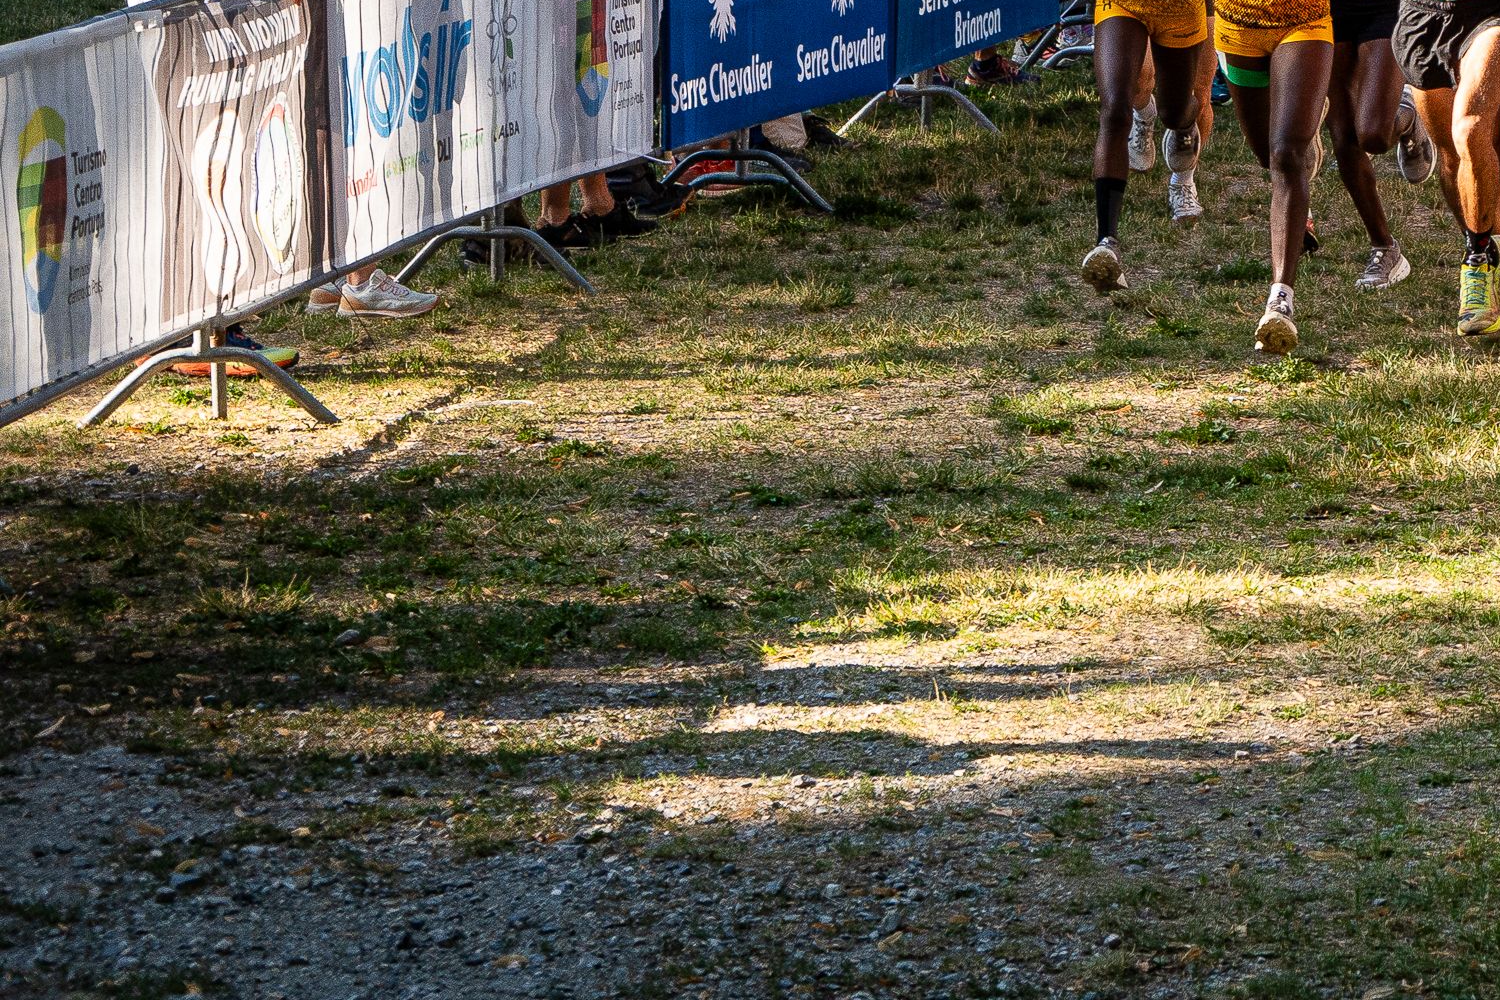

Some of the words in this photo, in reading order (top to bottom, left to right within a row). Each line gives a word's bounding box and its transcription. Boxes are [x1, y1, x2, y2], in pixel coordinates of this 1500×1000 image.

[610, 14, 636, 35] Centro
[796, 45, 828, 82] Serre
[831, 28, 886, 74] Chevalier
[671, 72, 707, 114] Serre
[710, 54, 774, 104] Chevalier
[70, 146, 107, 176] Turismo
[74, 181, 102, 208] Centro
